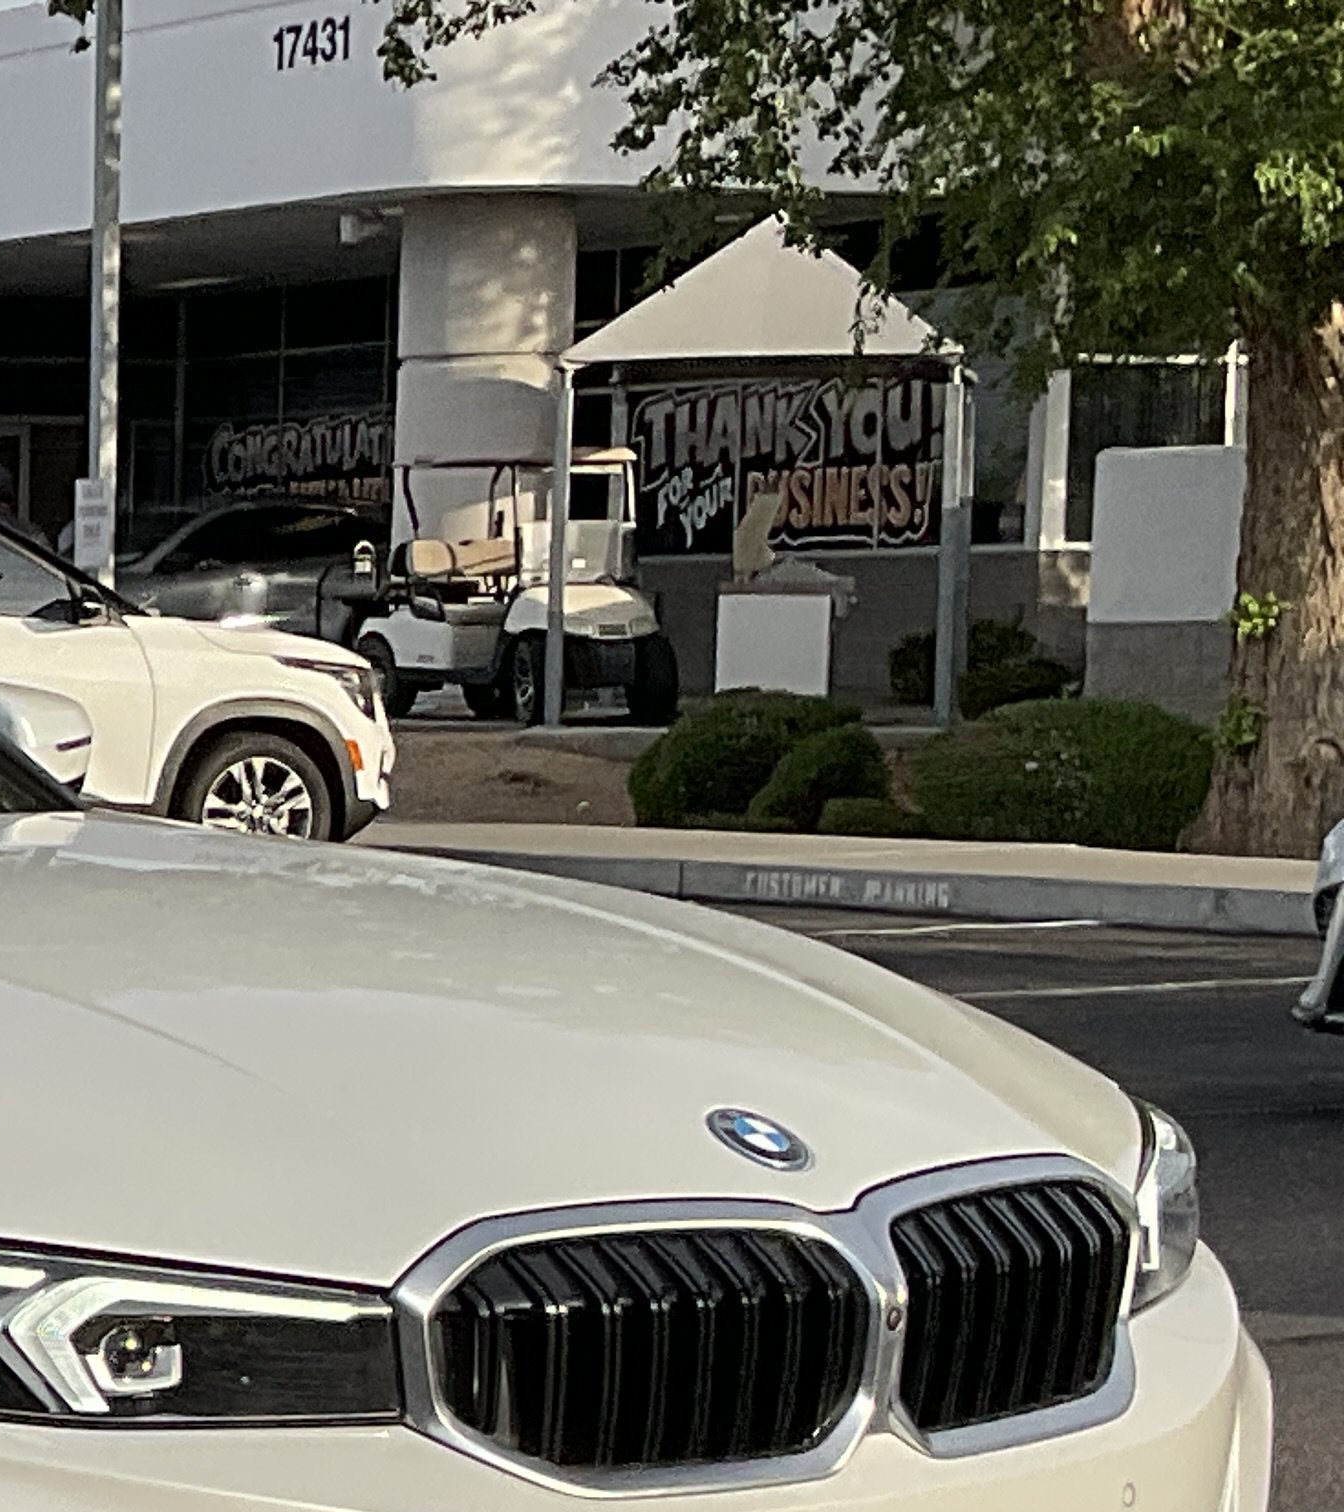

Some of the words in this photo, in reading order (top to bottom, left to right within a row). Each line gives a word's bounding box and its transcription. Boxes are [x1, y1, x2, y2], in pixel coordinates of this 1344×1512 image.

[273, 14, 350, 71] 17431
[643, 388, 812, 470] THANK
[656, 466, 694, 530] FOR
[679, 477, 734, 549] YOUR
